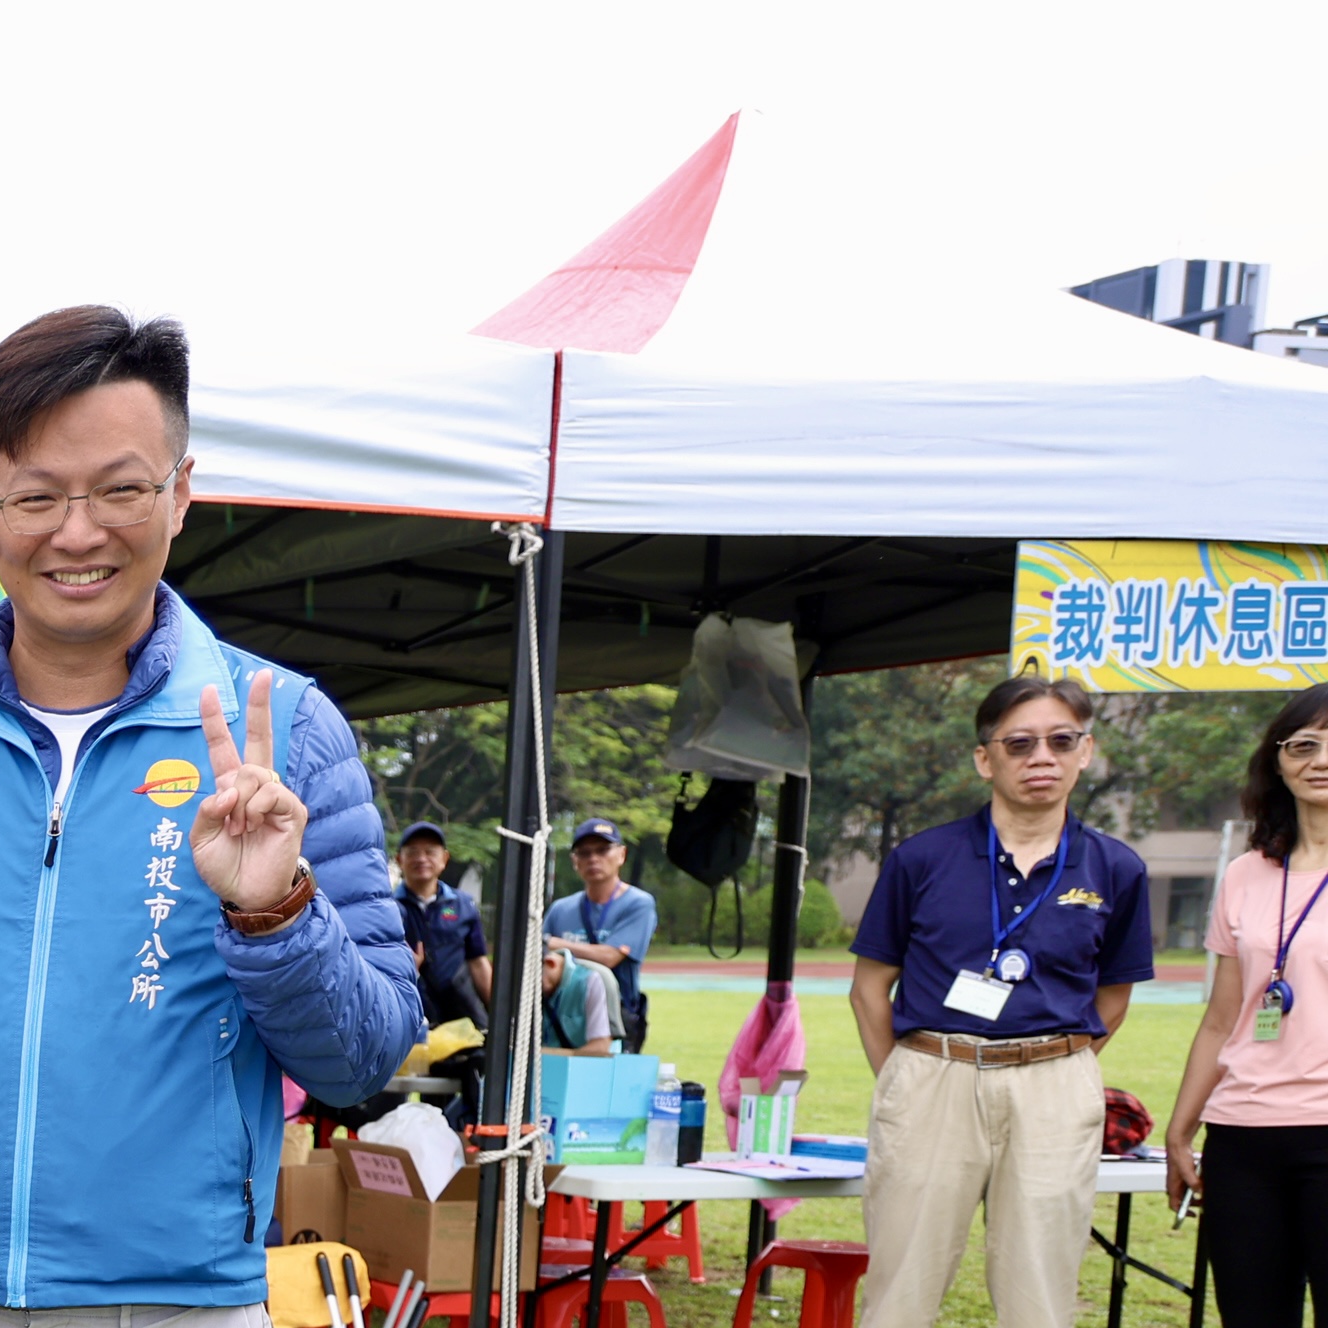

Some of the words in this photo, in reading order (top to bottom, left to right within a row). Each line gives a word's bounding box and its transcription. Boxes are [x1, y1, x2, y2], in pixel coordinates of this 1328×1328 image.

[1053, 582, 1328, 663] 裁判休息區
[129, 818, 183, 1010] 南投市公所
